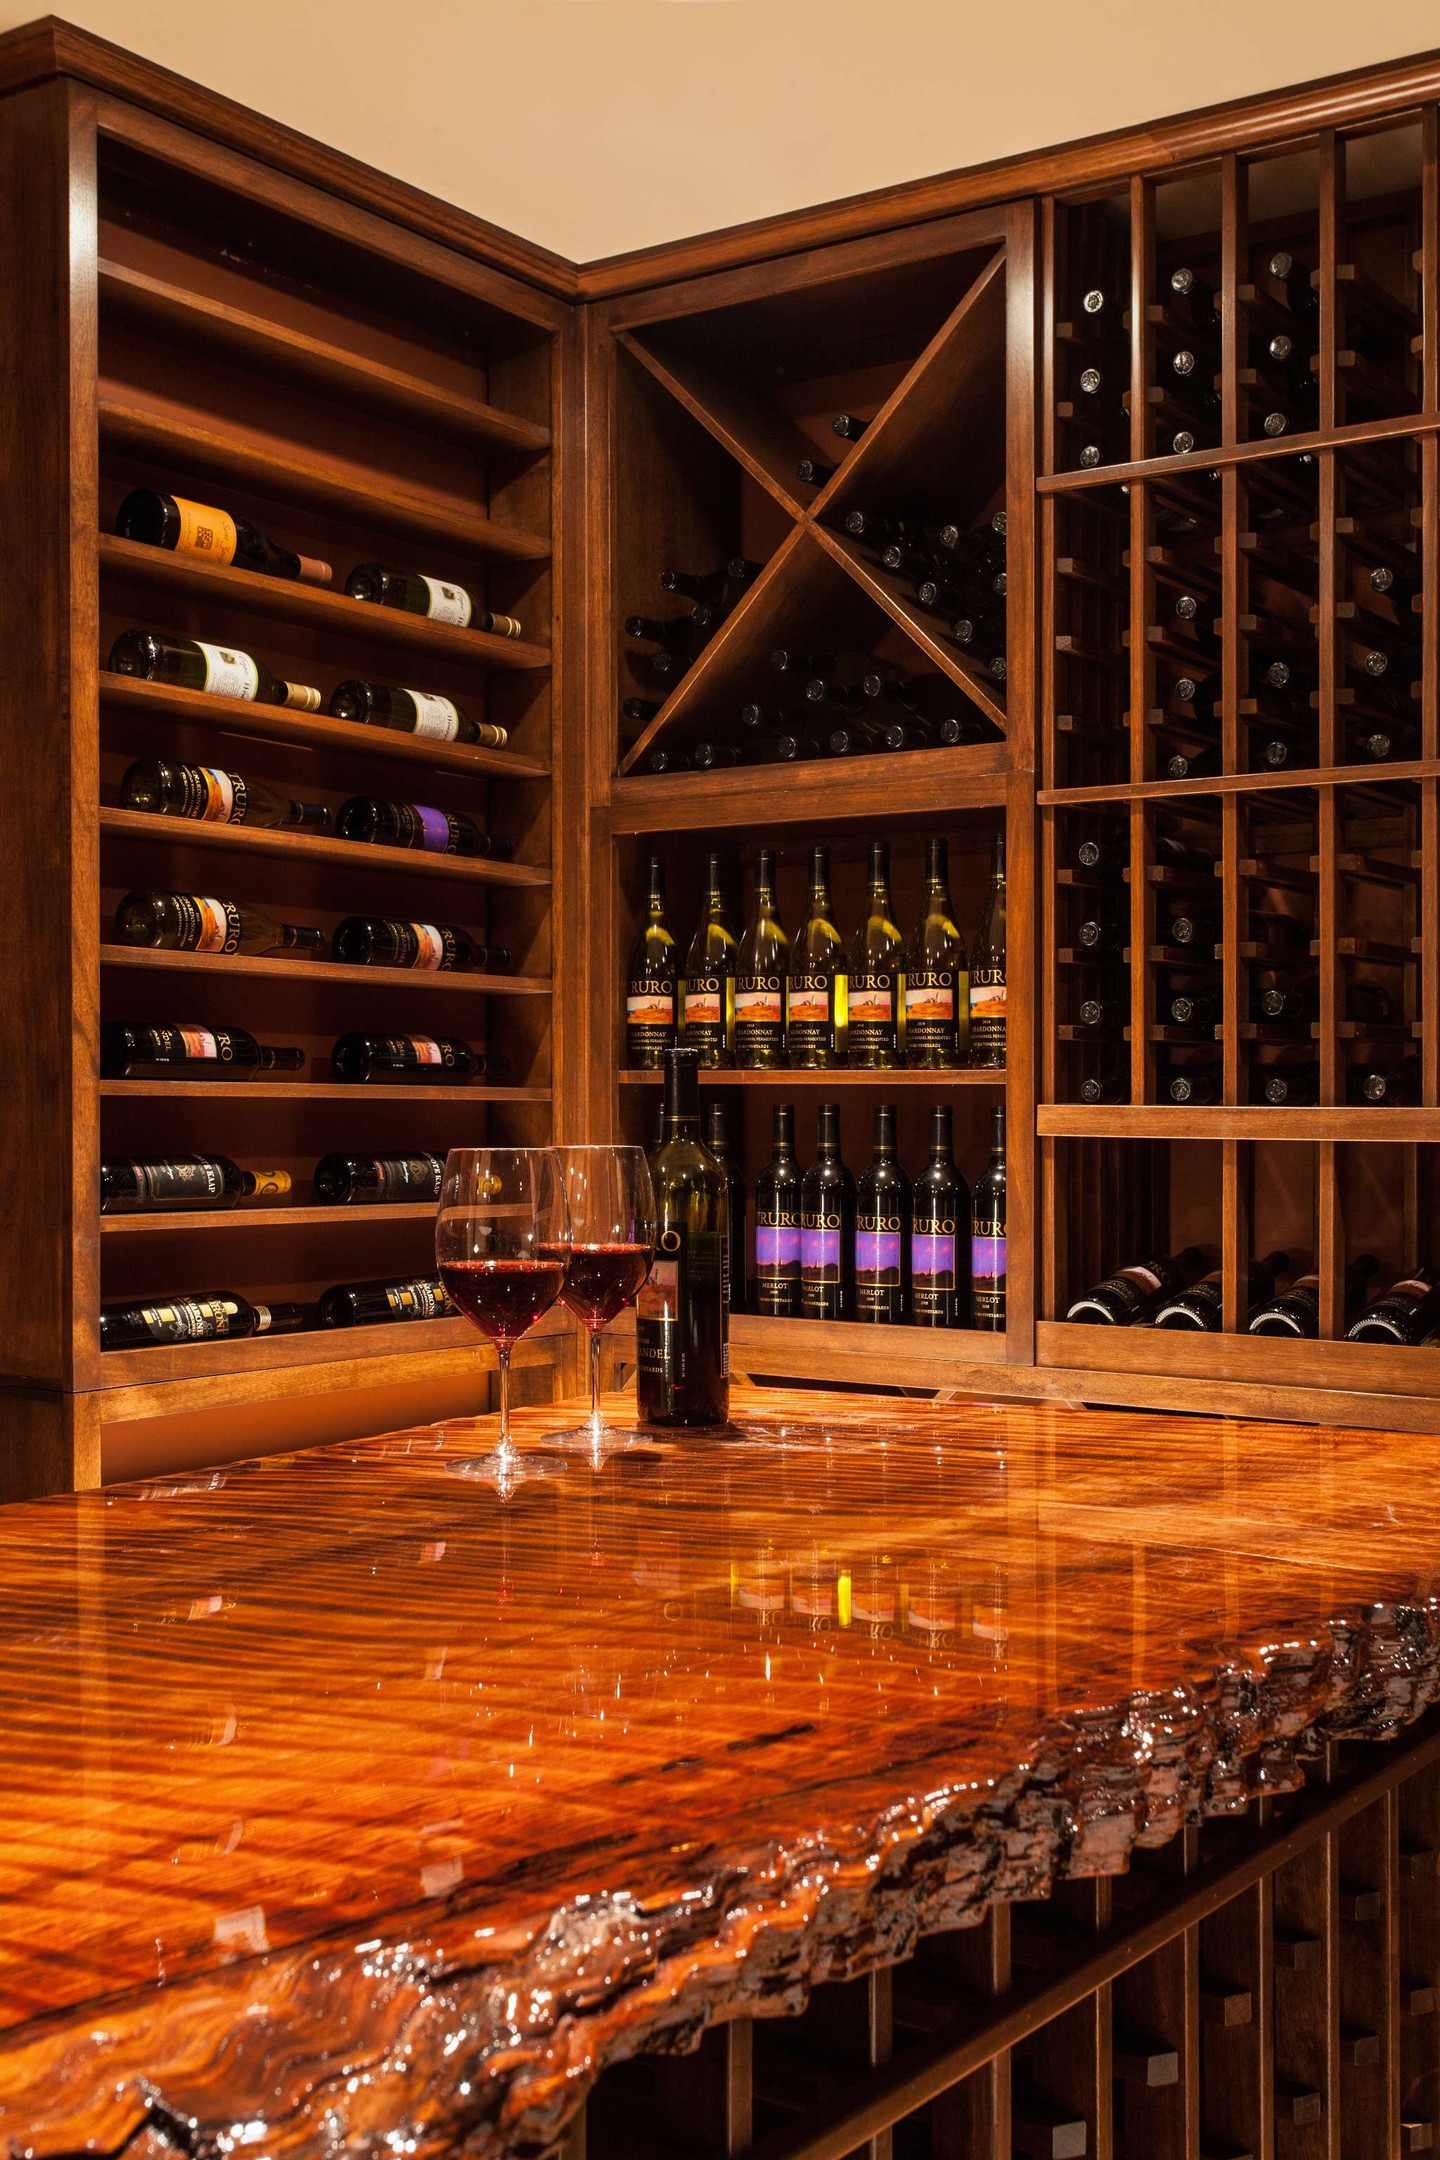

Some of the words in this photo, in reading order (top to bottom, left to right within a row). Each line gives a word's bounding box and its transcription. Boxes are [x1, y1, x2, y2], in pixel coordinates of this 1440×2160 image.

[446, 813, 460, 855] RURO
[222, 900, 240, 953] RURO
[440, 927, 456, 972] RURO
[737, 976, 780, 990] RURO
[789, 975, 828, 989] RURO
[849, 974, 890, 989] RURO
[907, 972, 952, 987] RURO
[973, 969, 1006, 983] RUR
[631, 979, 673, 994] RURO
[686, 977, 720, 992] URO
[972, 1025, 1006, 1033] HARDONNA
[216, 1032, 233, 1061] RO
[206, 1170, 216, 1193] KAAP
[757, 1211, 800, 1226] RURO
[857, 1215, 899, 1231] RURO
[913, 1218, 955, 1234] RURO
[972, 1220, 1006, 1236] RUR
[762, 1282, 788, 1290] MERLOT
[859, 1289, 885, 1297] MERLOT
[639, 1348, 671, 1359] ANDEL
